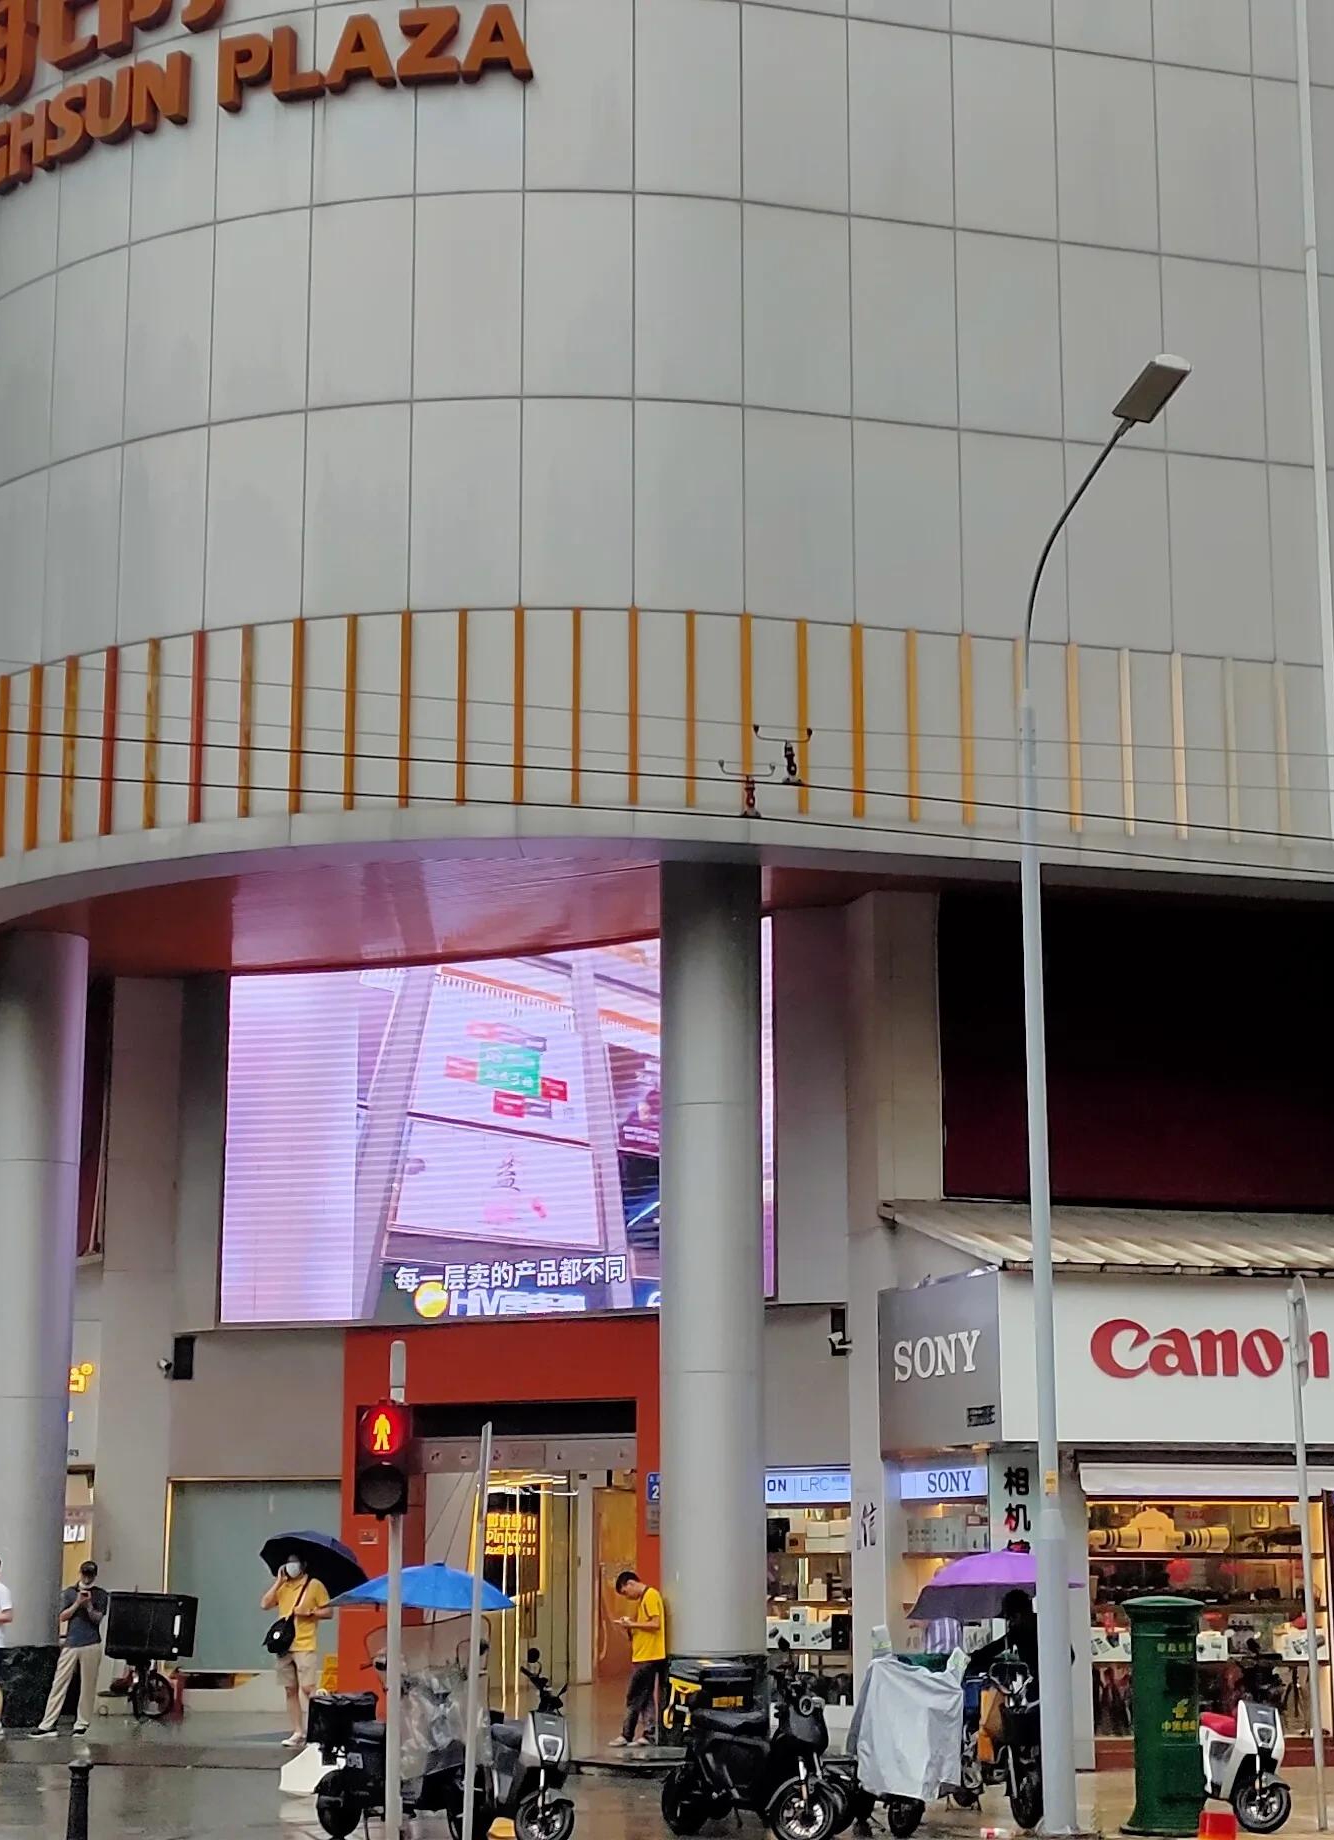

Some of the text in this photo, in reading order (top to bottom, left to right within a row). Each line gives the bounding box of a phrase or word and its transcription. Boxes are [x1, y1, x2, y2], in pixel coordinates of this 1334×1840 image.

[217, 3, 534, 113] PLAZA
[394, 1254, 628, 1292] 每一层卖的产品都不同
[893, 1329, 981, 1382] SONY
[1090, 1318, 1330, 1379] Canon
[926, 1469, 972, 1494] SONY
